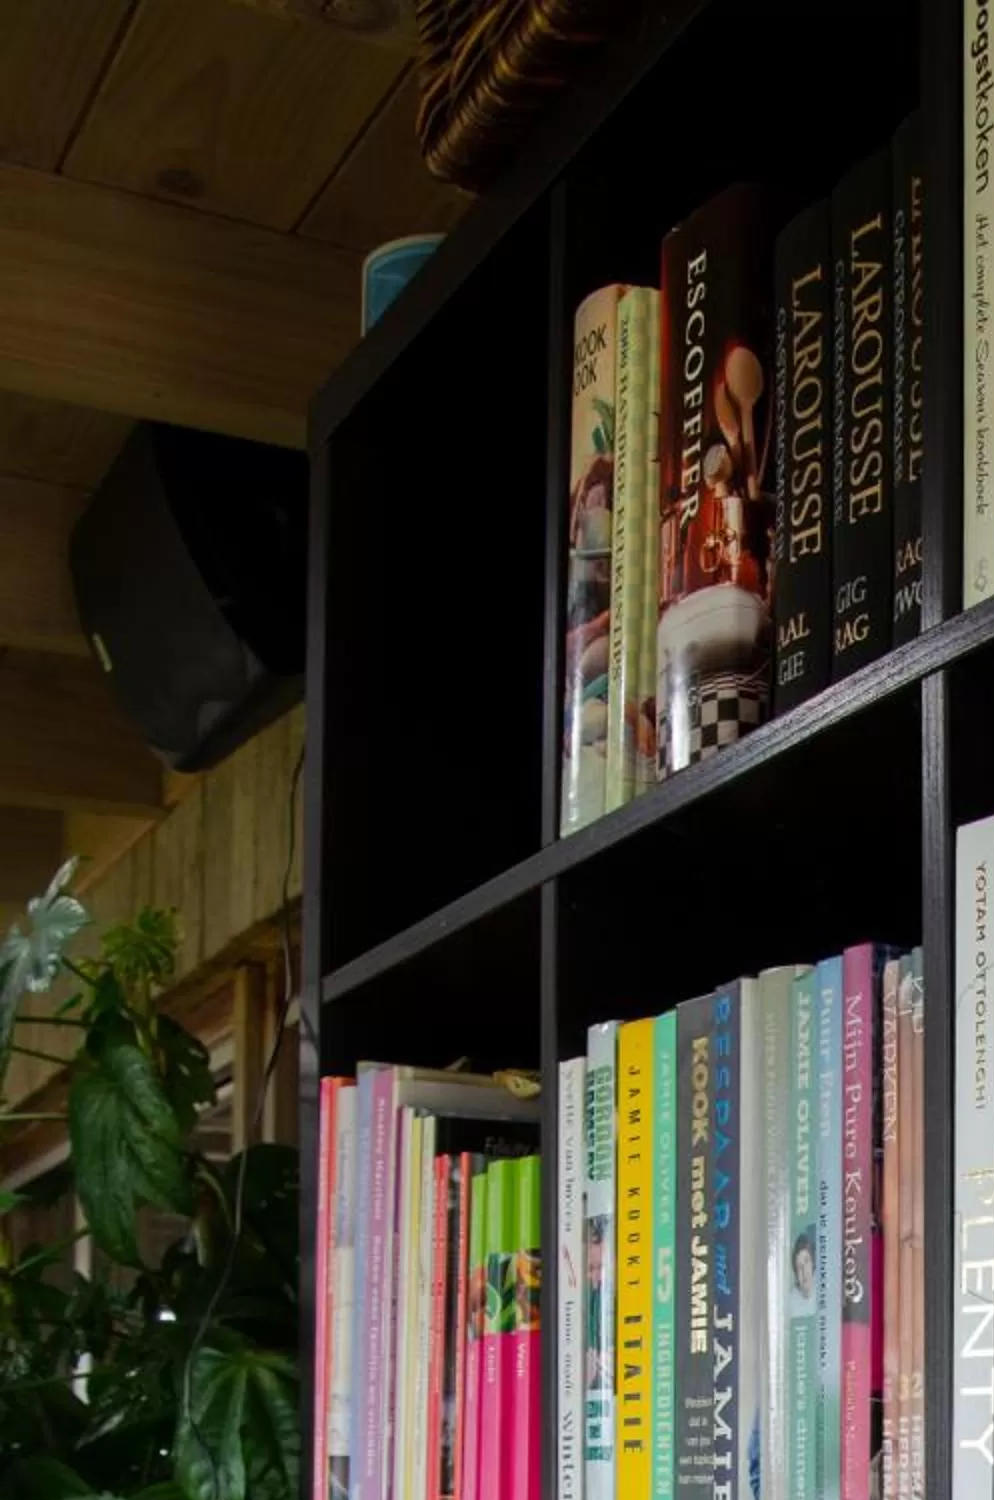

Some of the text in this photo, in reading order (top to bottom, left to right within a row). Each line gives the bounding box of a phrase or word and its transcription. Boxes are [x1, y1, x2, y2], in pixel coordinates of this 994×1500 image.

[848, 212, 885, 525] LAROUSSE
[972, 255, 989, 333] complete
[680, 249, 707, 529] ESCOFFIER
[789, 264, 825, 565] LAROUSSE
[843, 993, 863, 1073] Mijn
[973, 859, 988, 1111] YOTAM OTTOLENGHI
[596, 1065, 613, 1182] GORDON
[628, 1065, 641, 1164] JAMIE
[711, 996, 732, 1230] BESPAAR
[795, 991, 809, 1216] JAMIE OLIVER
[819, 987, 833, 1137] Puur Eten
[844, 1082, 861, 1159] Pure
[659, 1051, 672, 1225] JAMIE OLIVER
[690, 1036, 710, 1355] KOOK met JAMIE
[627, 1226, 641, 1288] KOOKT
[714, 1242, 733, 1296] met
[794, 1325, 808, 1412] jamie's
